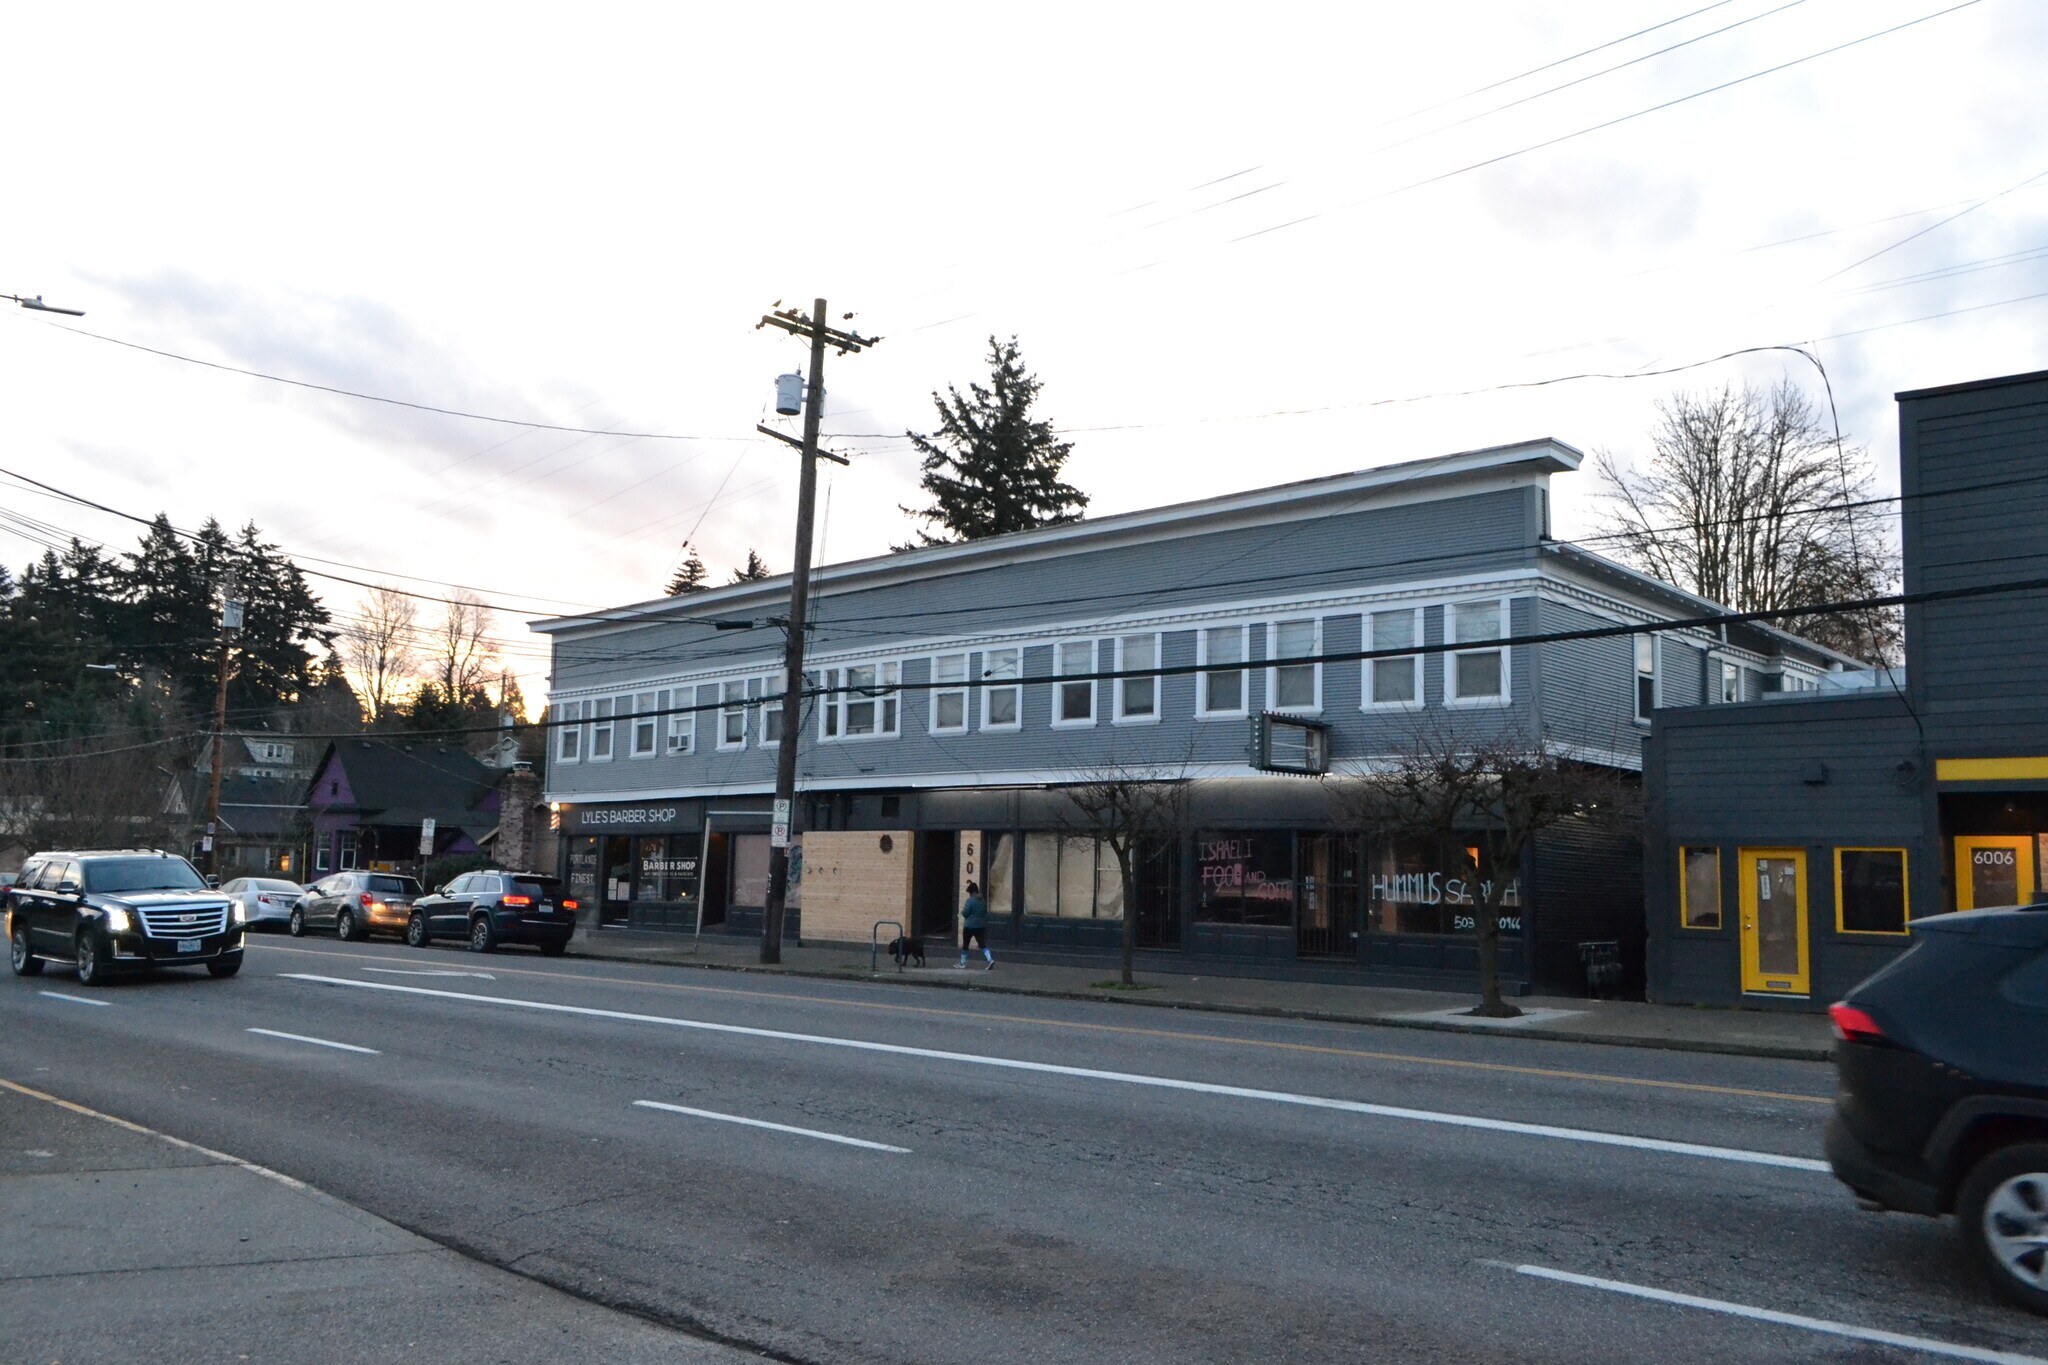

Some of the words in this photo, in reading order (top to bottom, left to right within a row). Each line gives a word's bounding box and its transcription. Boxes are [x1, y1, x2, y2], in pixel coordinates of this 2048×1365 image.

[609, 808, 647, 824] BARBER
[648, 808, 676, 822] SHOP
[1199, 838, 1253, 861] ISRAELI
[643, 860, 675, 871] BARBER
[676, 861, 696, 870] SHOP
[1974, 851, 2014, 865] 6006
[1372, 872, 1441, 905] HUMMUS
[1454, 915, 1475, 929] 503
